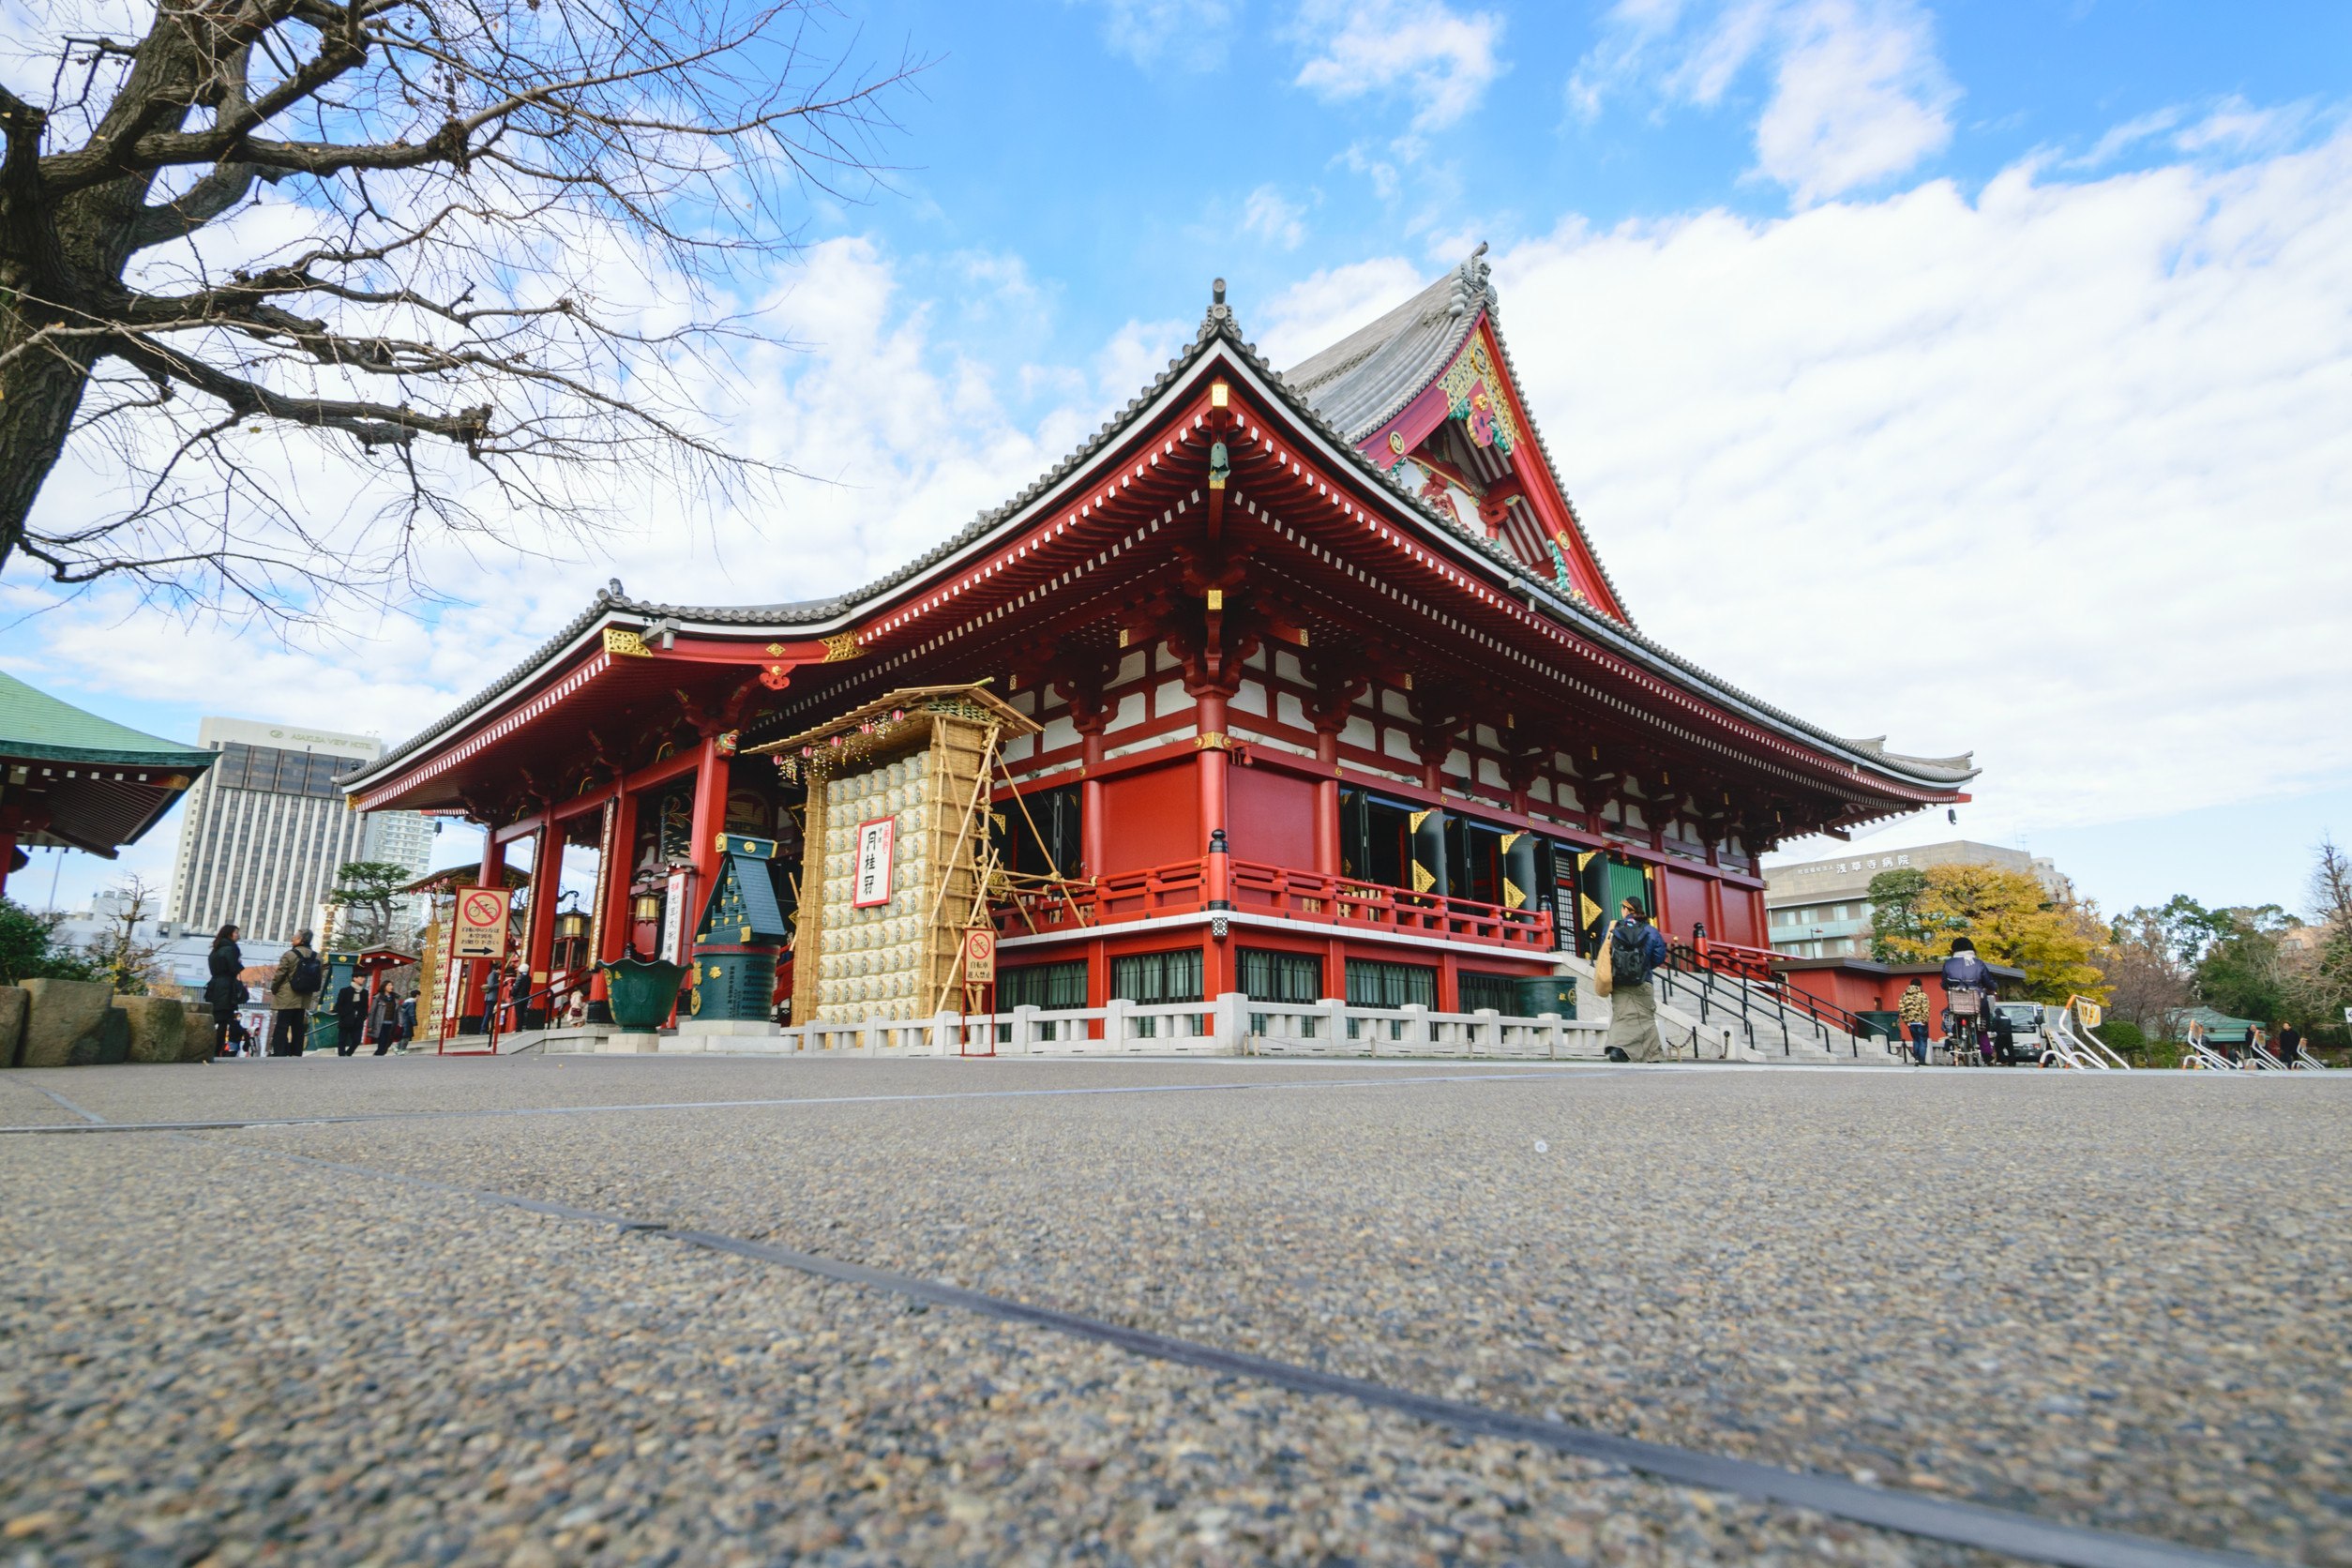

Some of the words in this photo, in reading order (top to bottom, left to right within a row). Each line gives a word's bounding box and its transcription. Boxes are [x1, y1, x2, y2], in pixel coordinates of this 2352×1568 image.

[291, 733, 325, 744] ASAKUSA
[327, 737, 348, 746] VIEW
[350, 741, 373, 750] HOTEL
[864, 830, 877, 896] 月桂冠
[1836, 854, 1910, 874] 浅草寺病院
